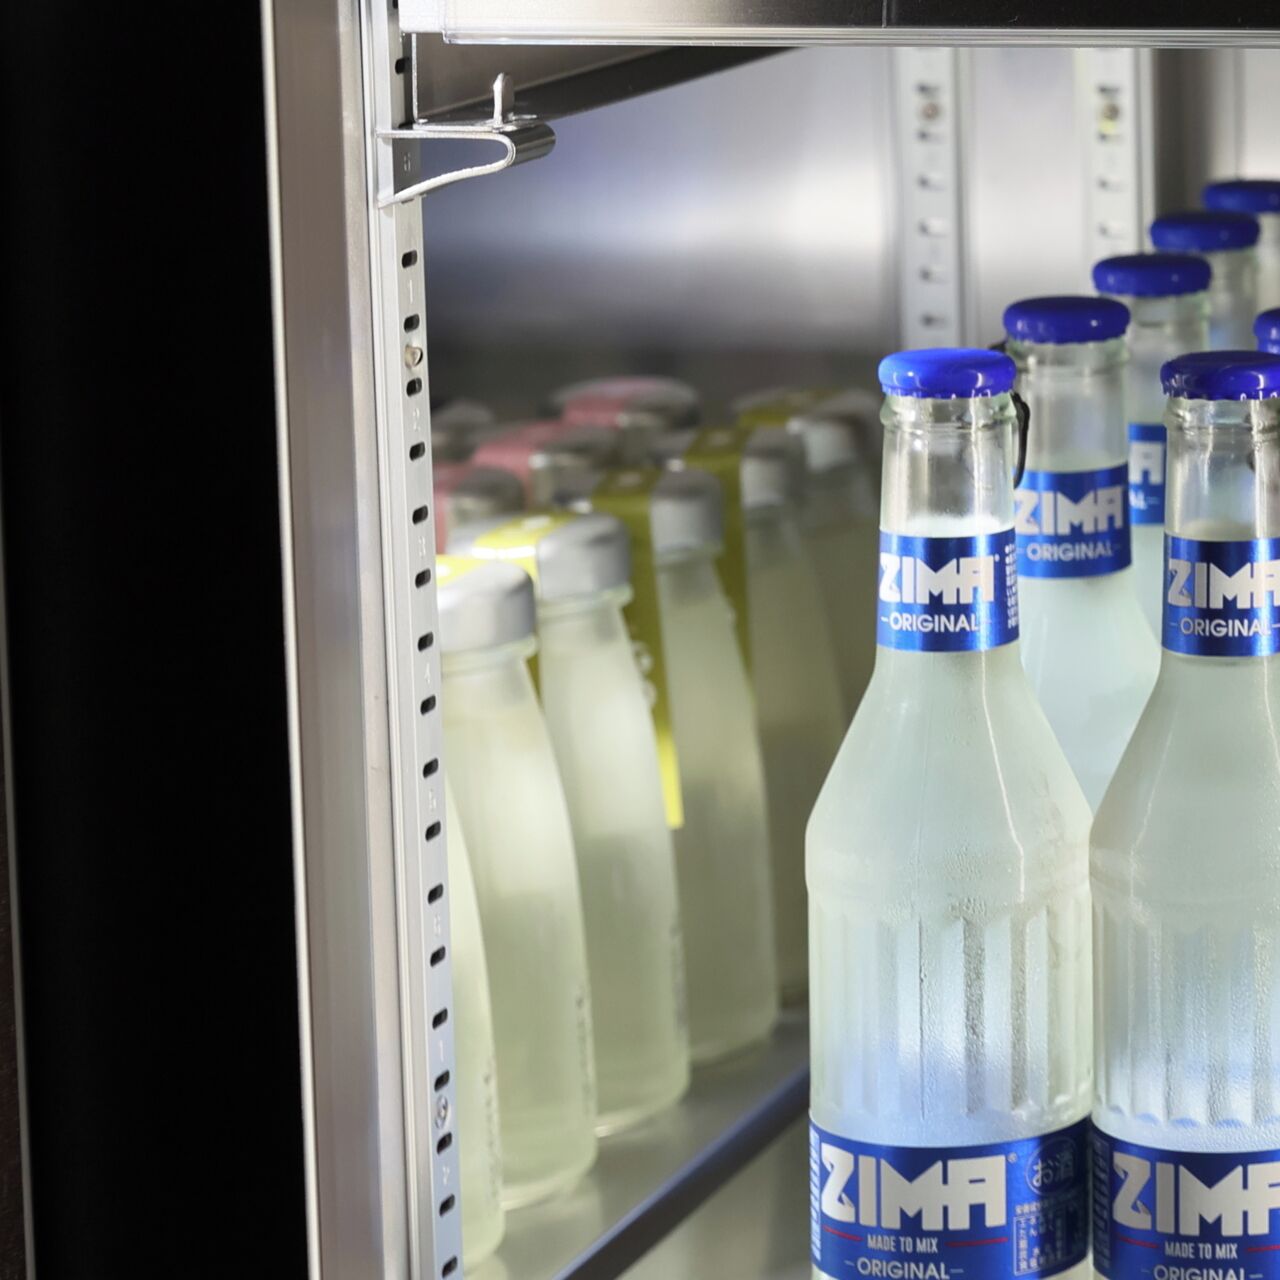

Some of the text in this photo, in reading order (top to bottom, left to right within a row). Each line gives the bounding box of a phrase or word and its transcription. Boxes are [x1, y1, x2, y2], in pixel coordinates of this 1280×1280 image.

[1015, 485, 1124, 536] ZIMA
[1026, 541, 1114, 562] ORIGINAL
[879, 552, 995, 605] ZIMA
[889, 611, 980, 633] ORIGINAL
[1180, 618, 1271, 638] ORIGINAL
[820, 1143, 1007, 1232] ZIMA
[867, 1234, 939, 1254] MADE TO MIX
[1164, 1241, 1239, 1260] MADE TO MIX
[857, 1256, 949, 1280] ORIGINAL
